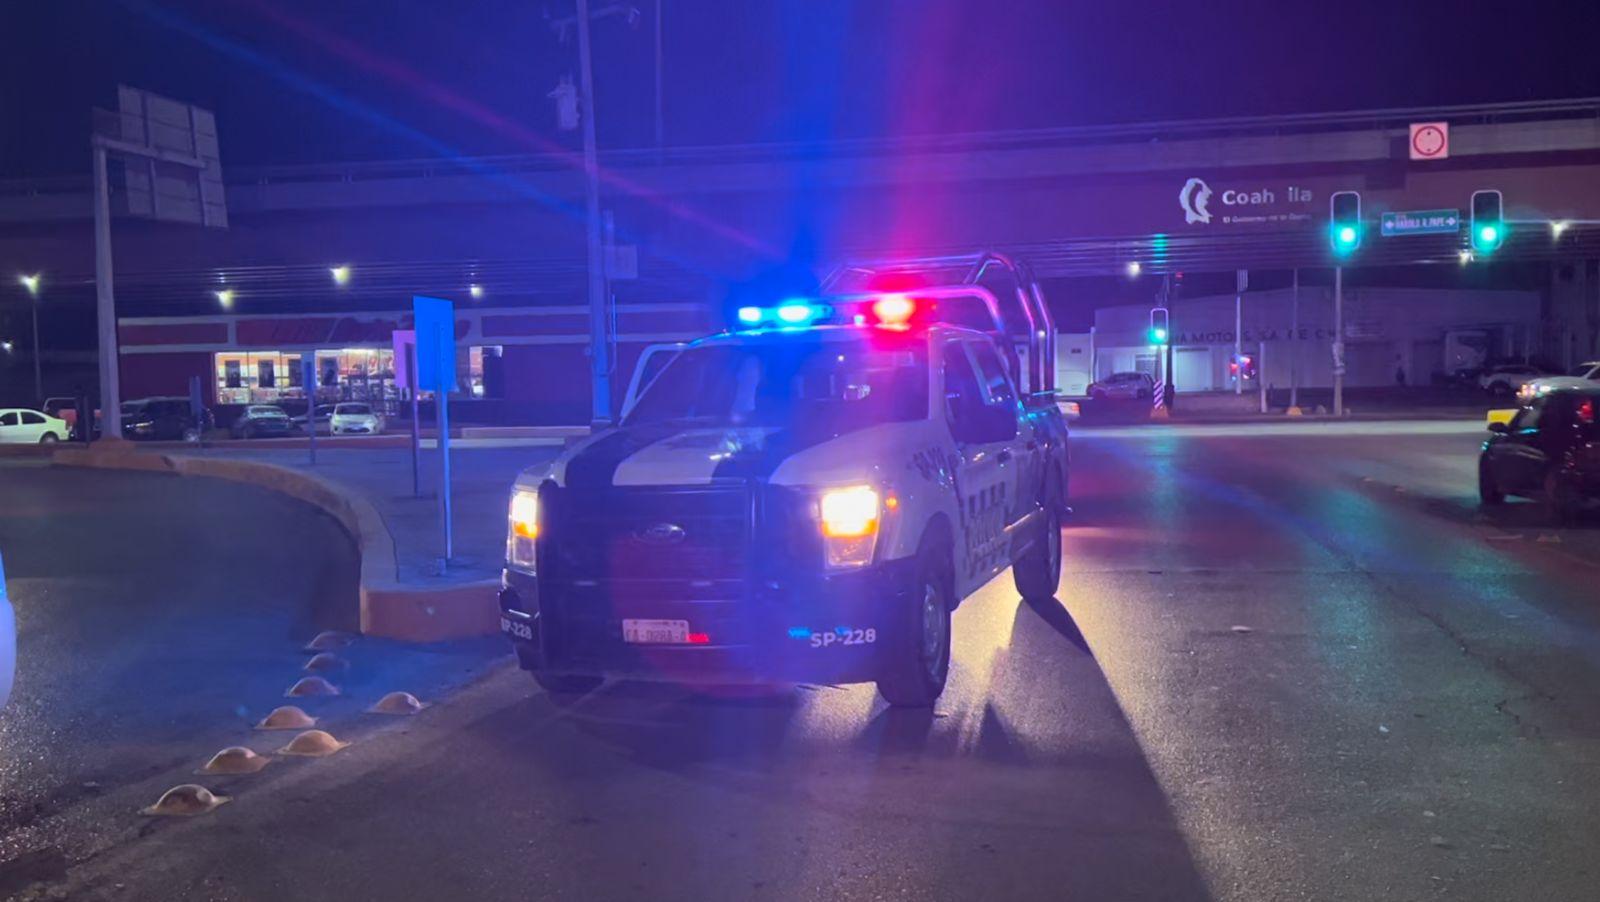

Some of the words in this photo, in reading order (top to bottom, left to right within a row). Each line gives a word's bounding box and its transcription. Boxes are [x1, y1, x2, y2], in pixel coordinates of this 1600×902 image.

[1222, 187, 1312, 205] Coahila
[1191, 328, 1251, 344] MOTOS
[810, 628, 876, 648] SP-228
